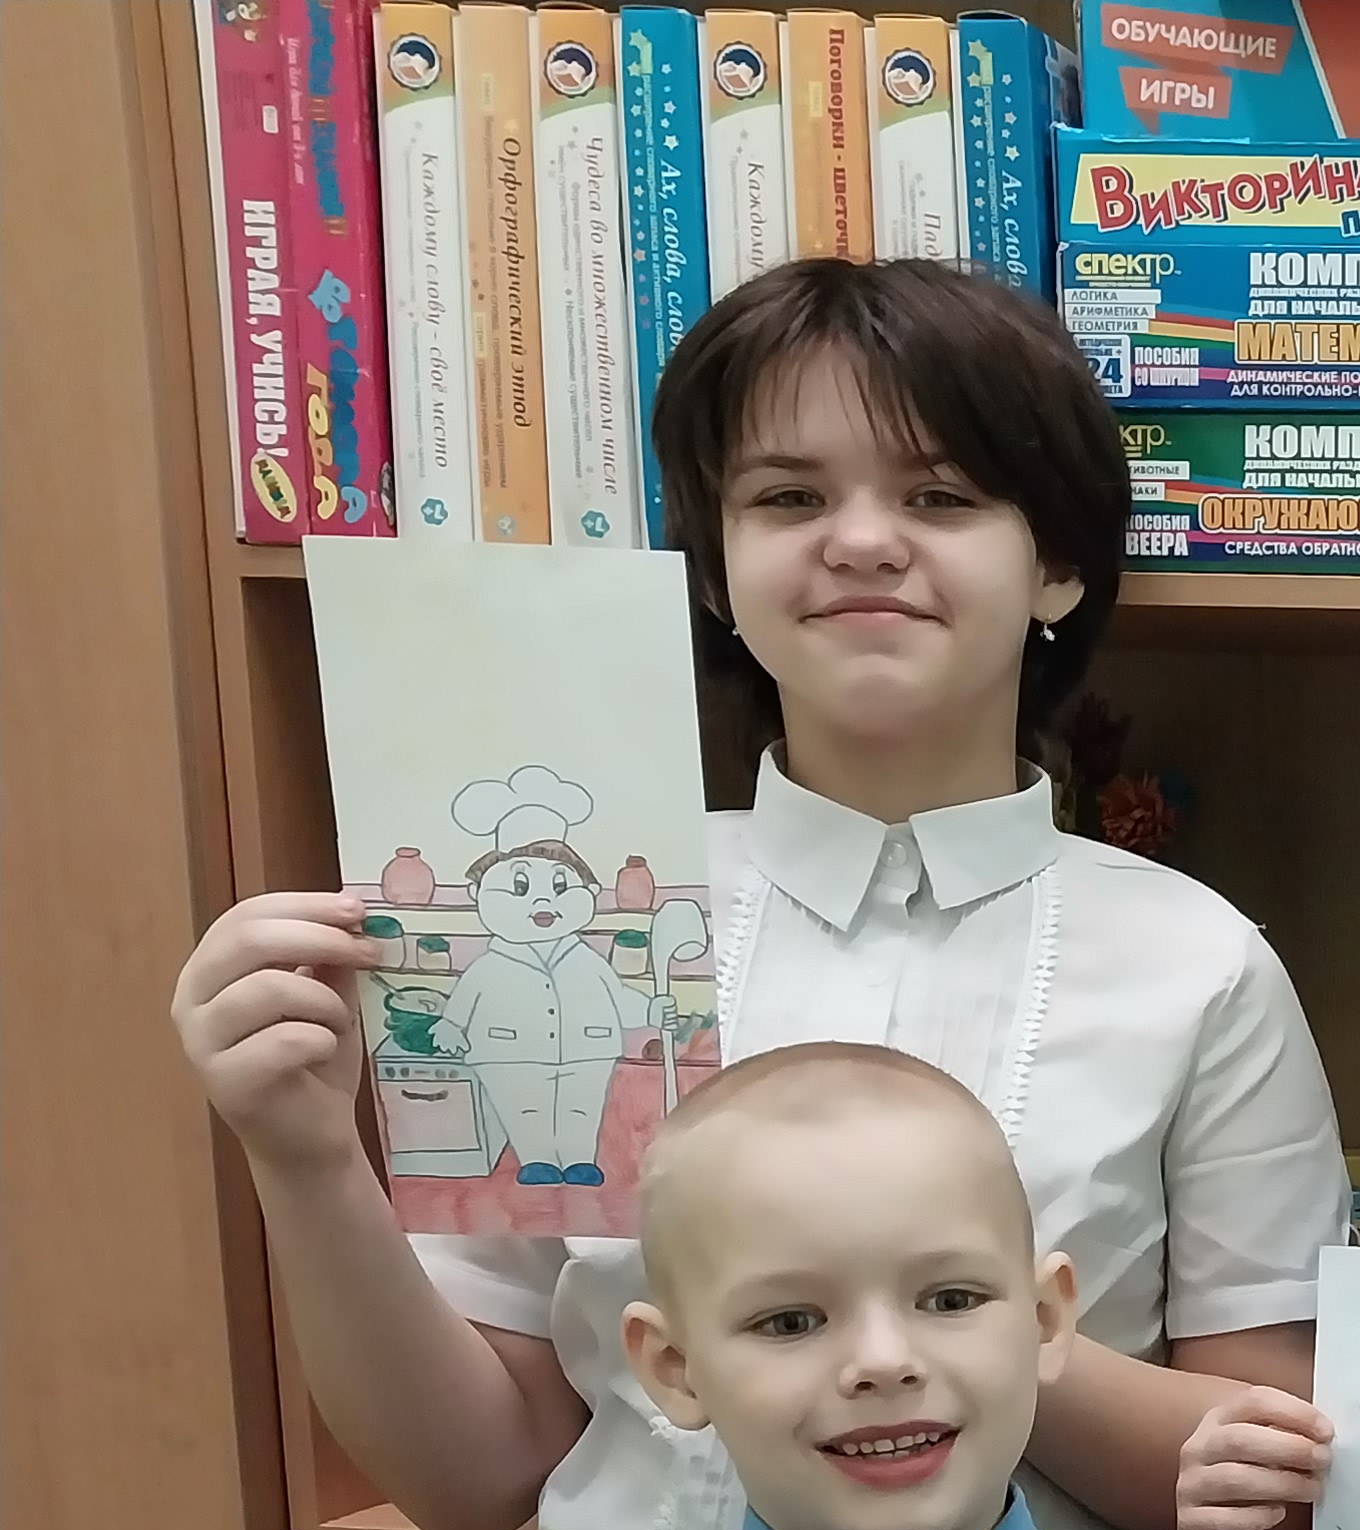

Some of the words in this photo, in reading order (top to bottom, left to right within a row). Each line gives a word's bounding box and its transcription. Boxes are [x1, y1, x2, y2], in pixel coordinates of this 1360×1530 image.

[1110, 17, 1278, 59] ОБУЧАЮЩИЕ
[827, 28, 846, 150] Поговорки
[1139, 78, 1215, 110] ИГРЫ
[582, 137, 606, 212] Чудеса
[657, 159, 682, 200] Ах,
[1000, 169, 1023, 212] Ах,
[421, 153, 441, 258] Каждому
[747, 162, 767, 269] Каждому
[832, 167, 851, 259] цветочк
[498, 138, 526, 356] Орфографический
[589, 220, 609, 244] во
[662, 207, 687, 284] слова,
[923, 212, 942, 259] Пад
[242, 200, 282, 325] ИГРАЯ,
[424, 264, 446, 325] слову
[1070, 290, 1119, 301] ЛОГИКА
[1071, 306, 1149, 317] АРИФМЕТИКА
[1247, 300, 1288, 318] ДЛЯ
[591, 250, 617, 431] множественном
[667, 291, 686, 354] слов
[1071, 320, 1139, 332] ГЕОМЕТРИЯ
[429, 346, 448, 394] своё
[1133, 345, 1200, 366] ПОСОБИЯ
[1226, 369, 1338, 384] ДИНАМИЧЕСКИЕ
[249, 328, 289, 458] УЧИСЬ!
[510, 361, 533, 428] этюд
[1229, 384, 1259, 399] ДЛЯ
[431, 401, 449, 469] место
[601, 438, 619, 496] числе
[1129, 464, 1181, 476] ИВОТНЫЕ
[1241, 472, 1282, 490] ДЛЯ
[1131, 485, 1158, 496] НАКИ
[1125, 531, 1190, 557] ВЕЕРА
[1223, 541, 1300, 557] СРЕДСТВА
